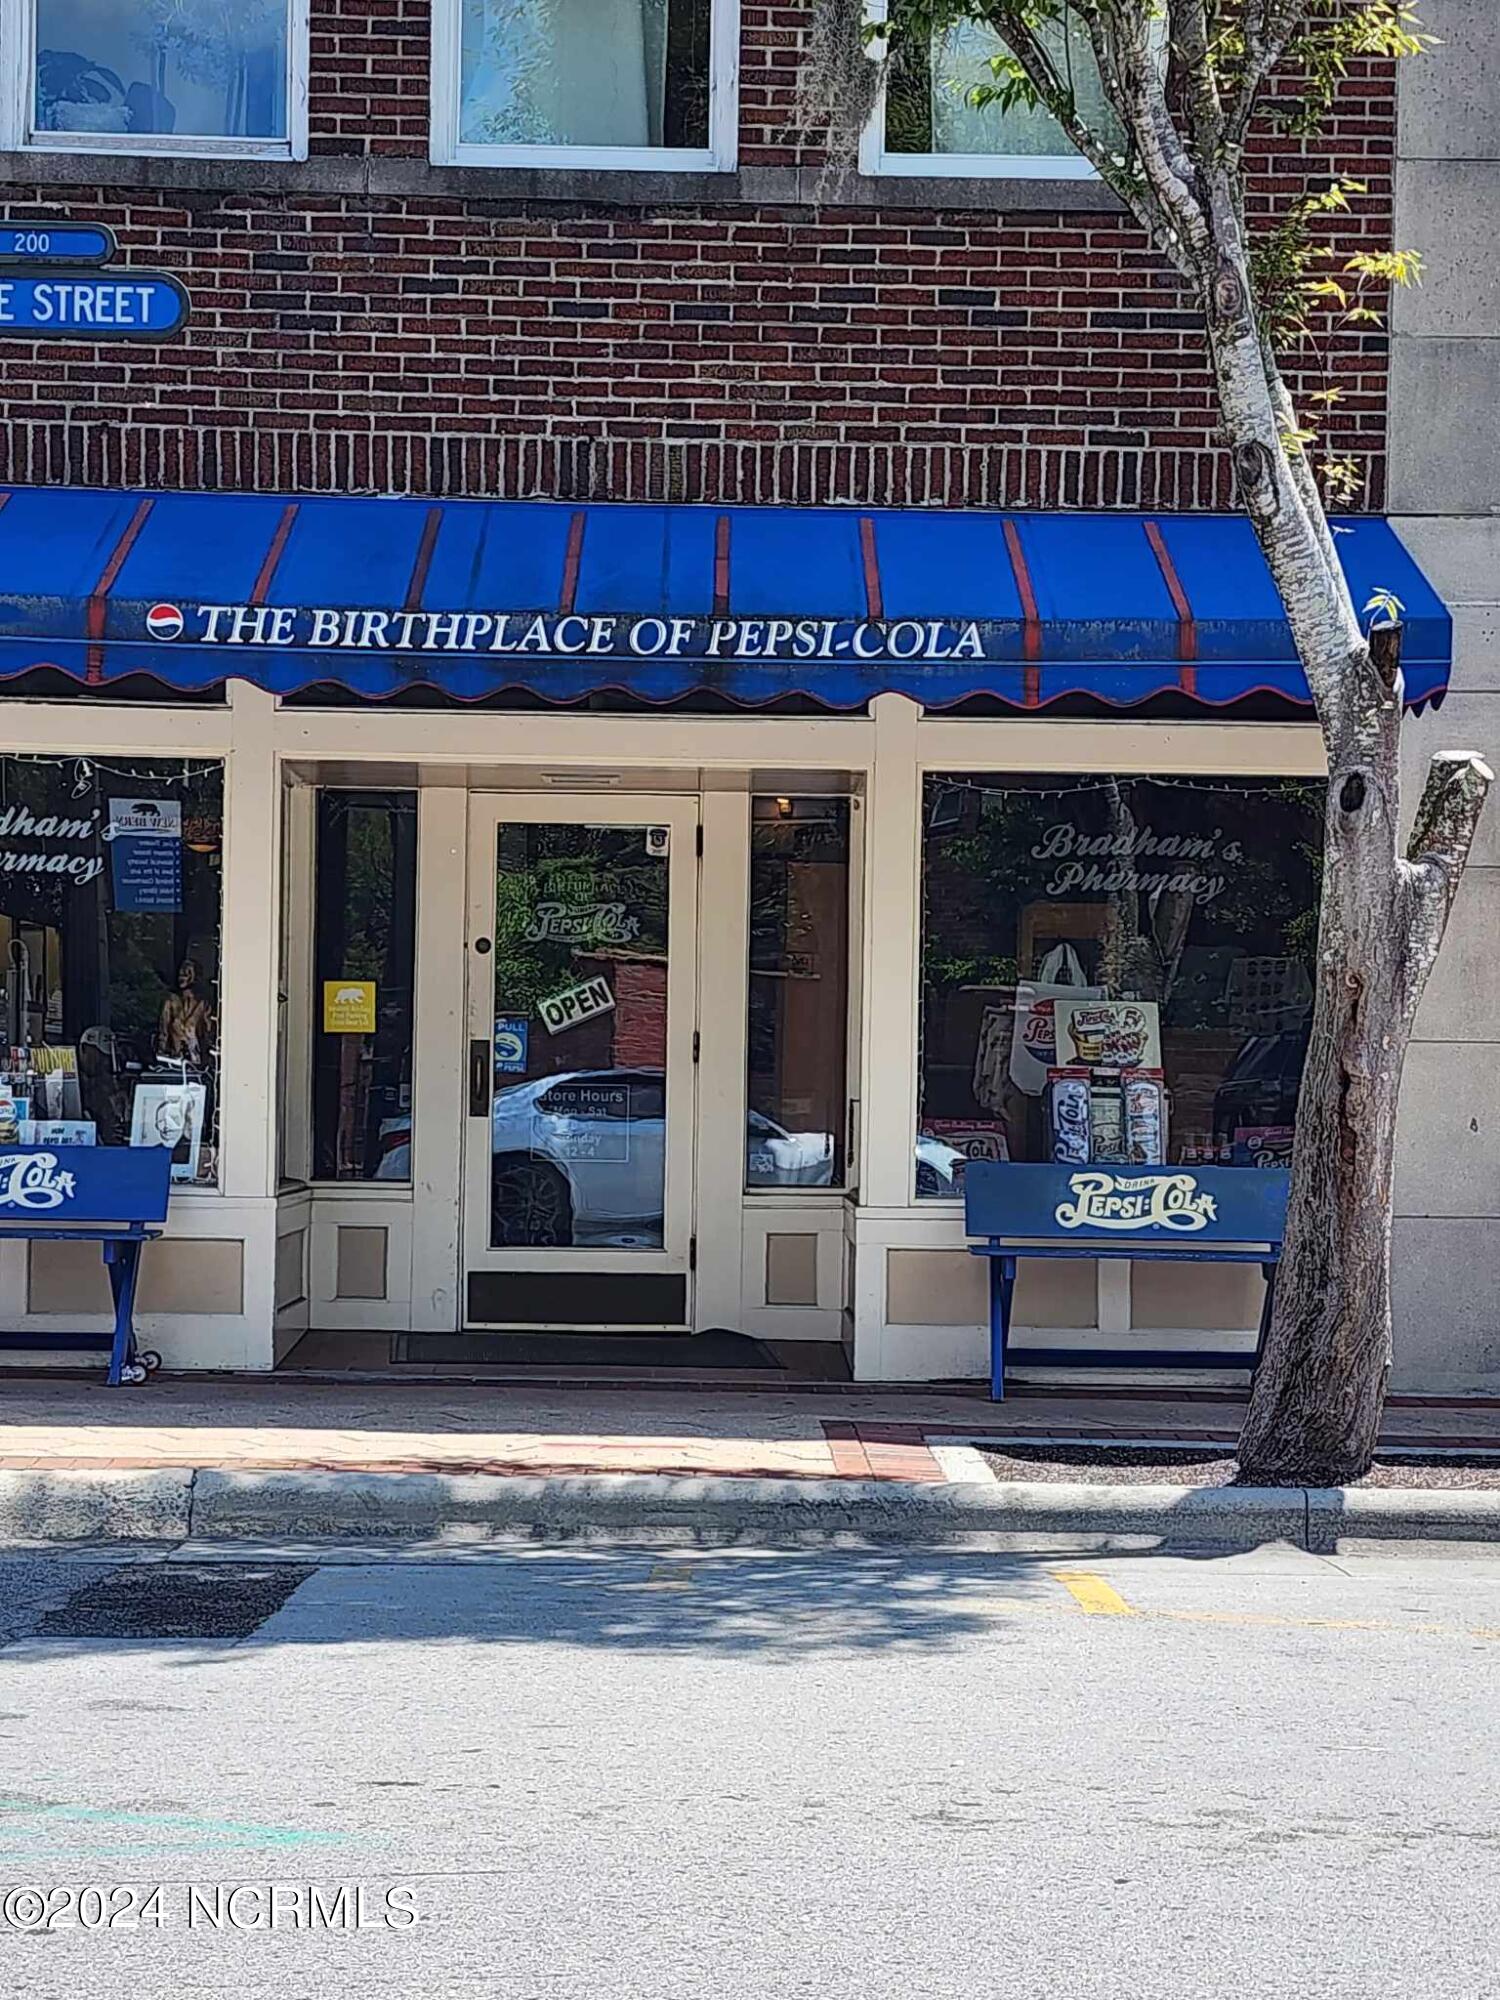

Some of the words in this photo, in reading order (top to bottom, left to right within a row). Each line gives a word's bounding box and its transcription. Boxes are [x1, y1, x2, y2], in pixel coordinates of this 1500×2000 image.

[14, 233, 50, 253] 200
[32, 284, 155, 323] STREET
[197, 605, 297, 645] THE
[307, 608, 617, 655] BIRTHPLACE
[629, 617, 695, 656] OF
[704, 619, 987, 660] PEPSI-COLA
[1030, 822, 1242, 861] Bradham's
[0, 851, 105, 886] rmacy
[1046, 860, 1226, 905] Pharmacy
[544, 984, 611, 1027] OPEN
[497, 1023, 525, 1032] PULL
[580, 1088, 624, 1103] Hours
[1123, 1178, 1156, 1190] DRINK
